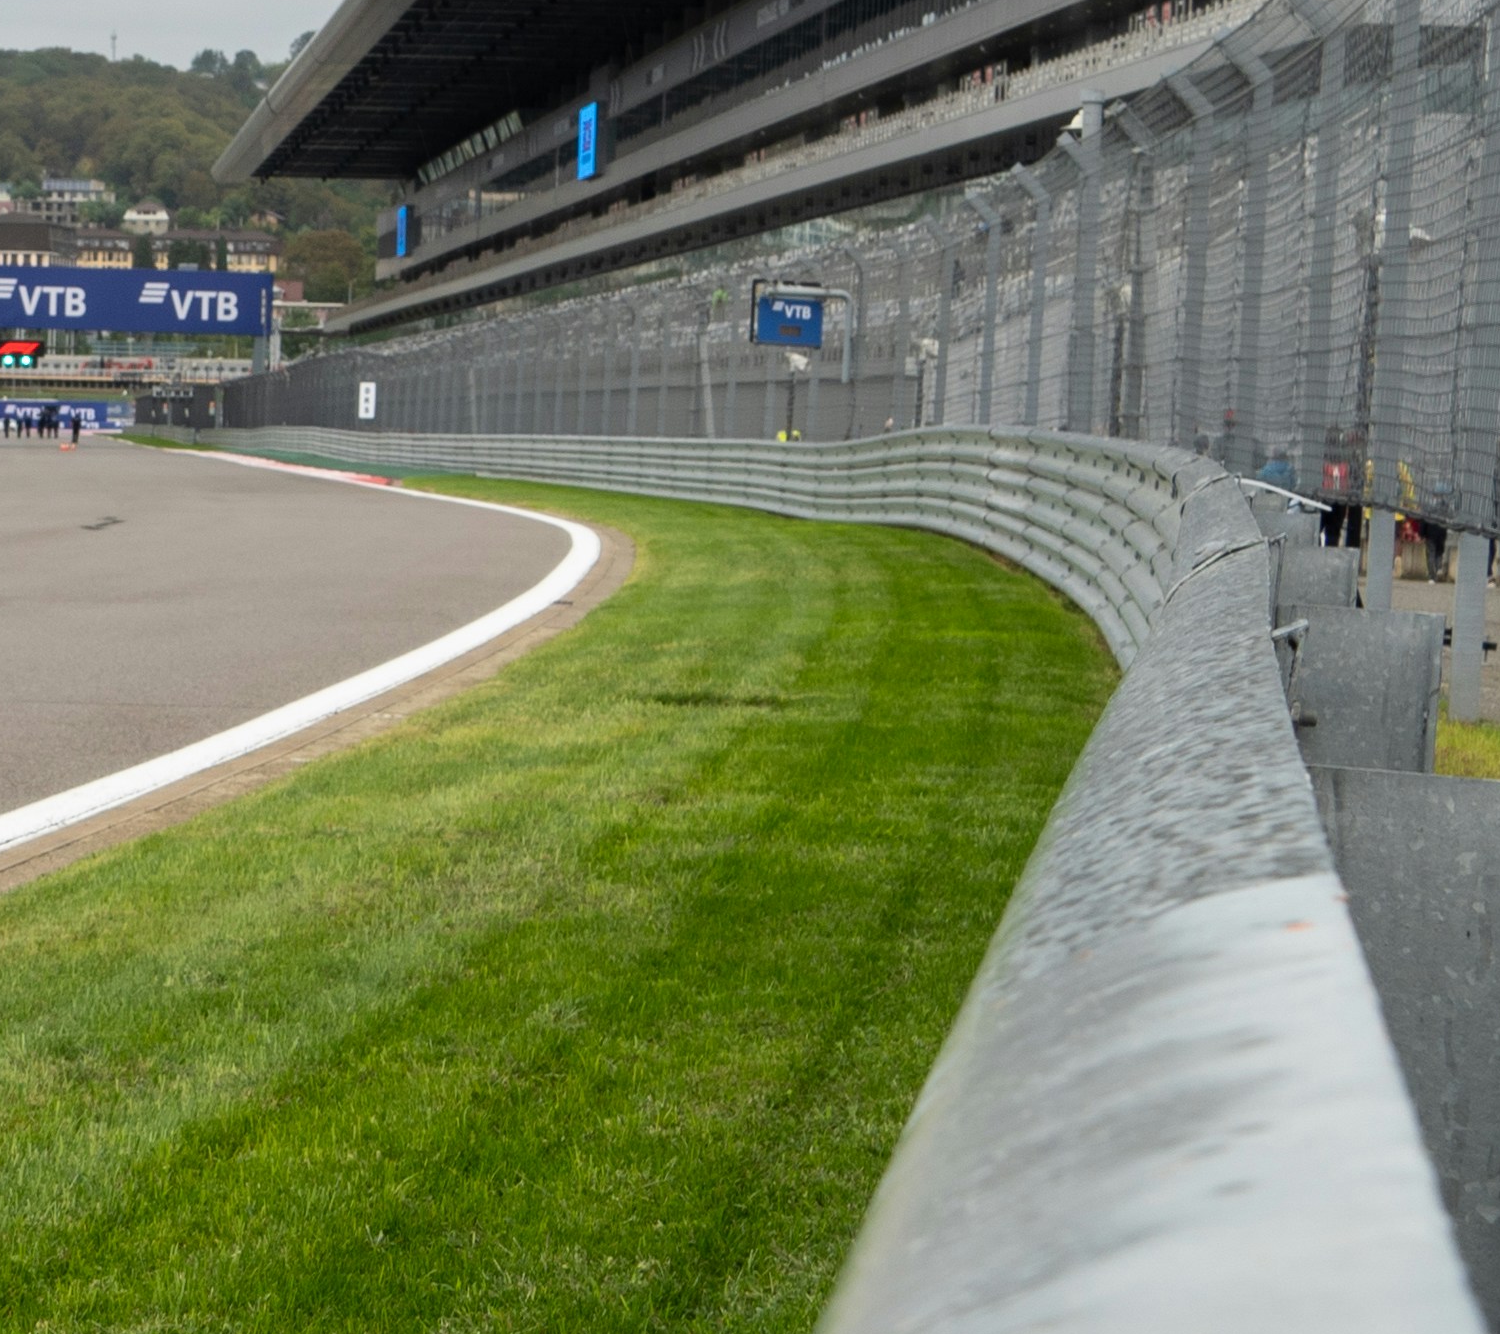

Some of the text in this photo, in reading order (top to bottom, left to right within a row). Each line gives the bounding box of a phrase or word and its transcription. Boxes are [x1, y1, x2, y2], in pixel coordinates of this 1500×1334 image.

[19, 285, 87, 318] VTB
[171, 289, 239, 322] VTB
[784, 304, 812, 321] VTB
